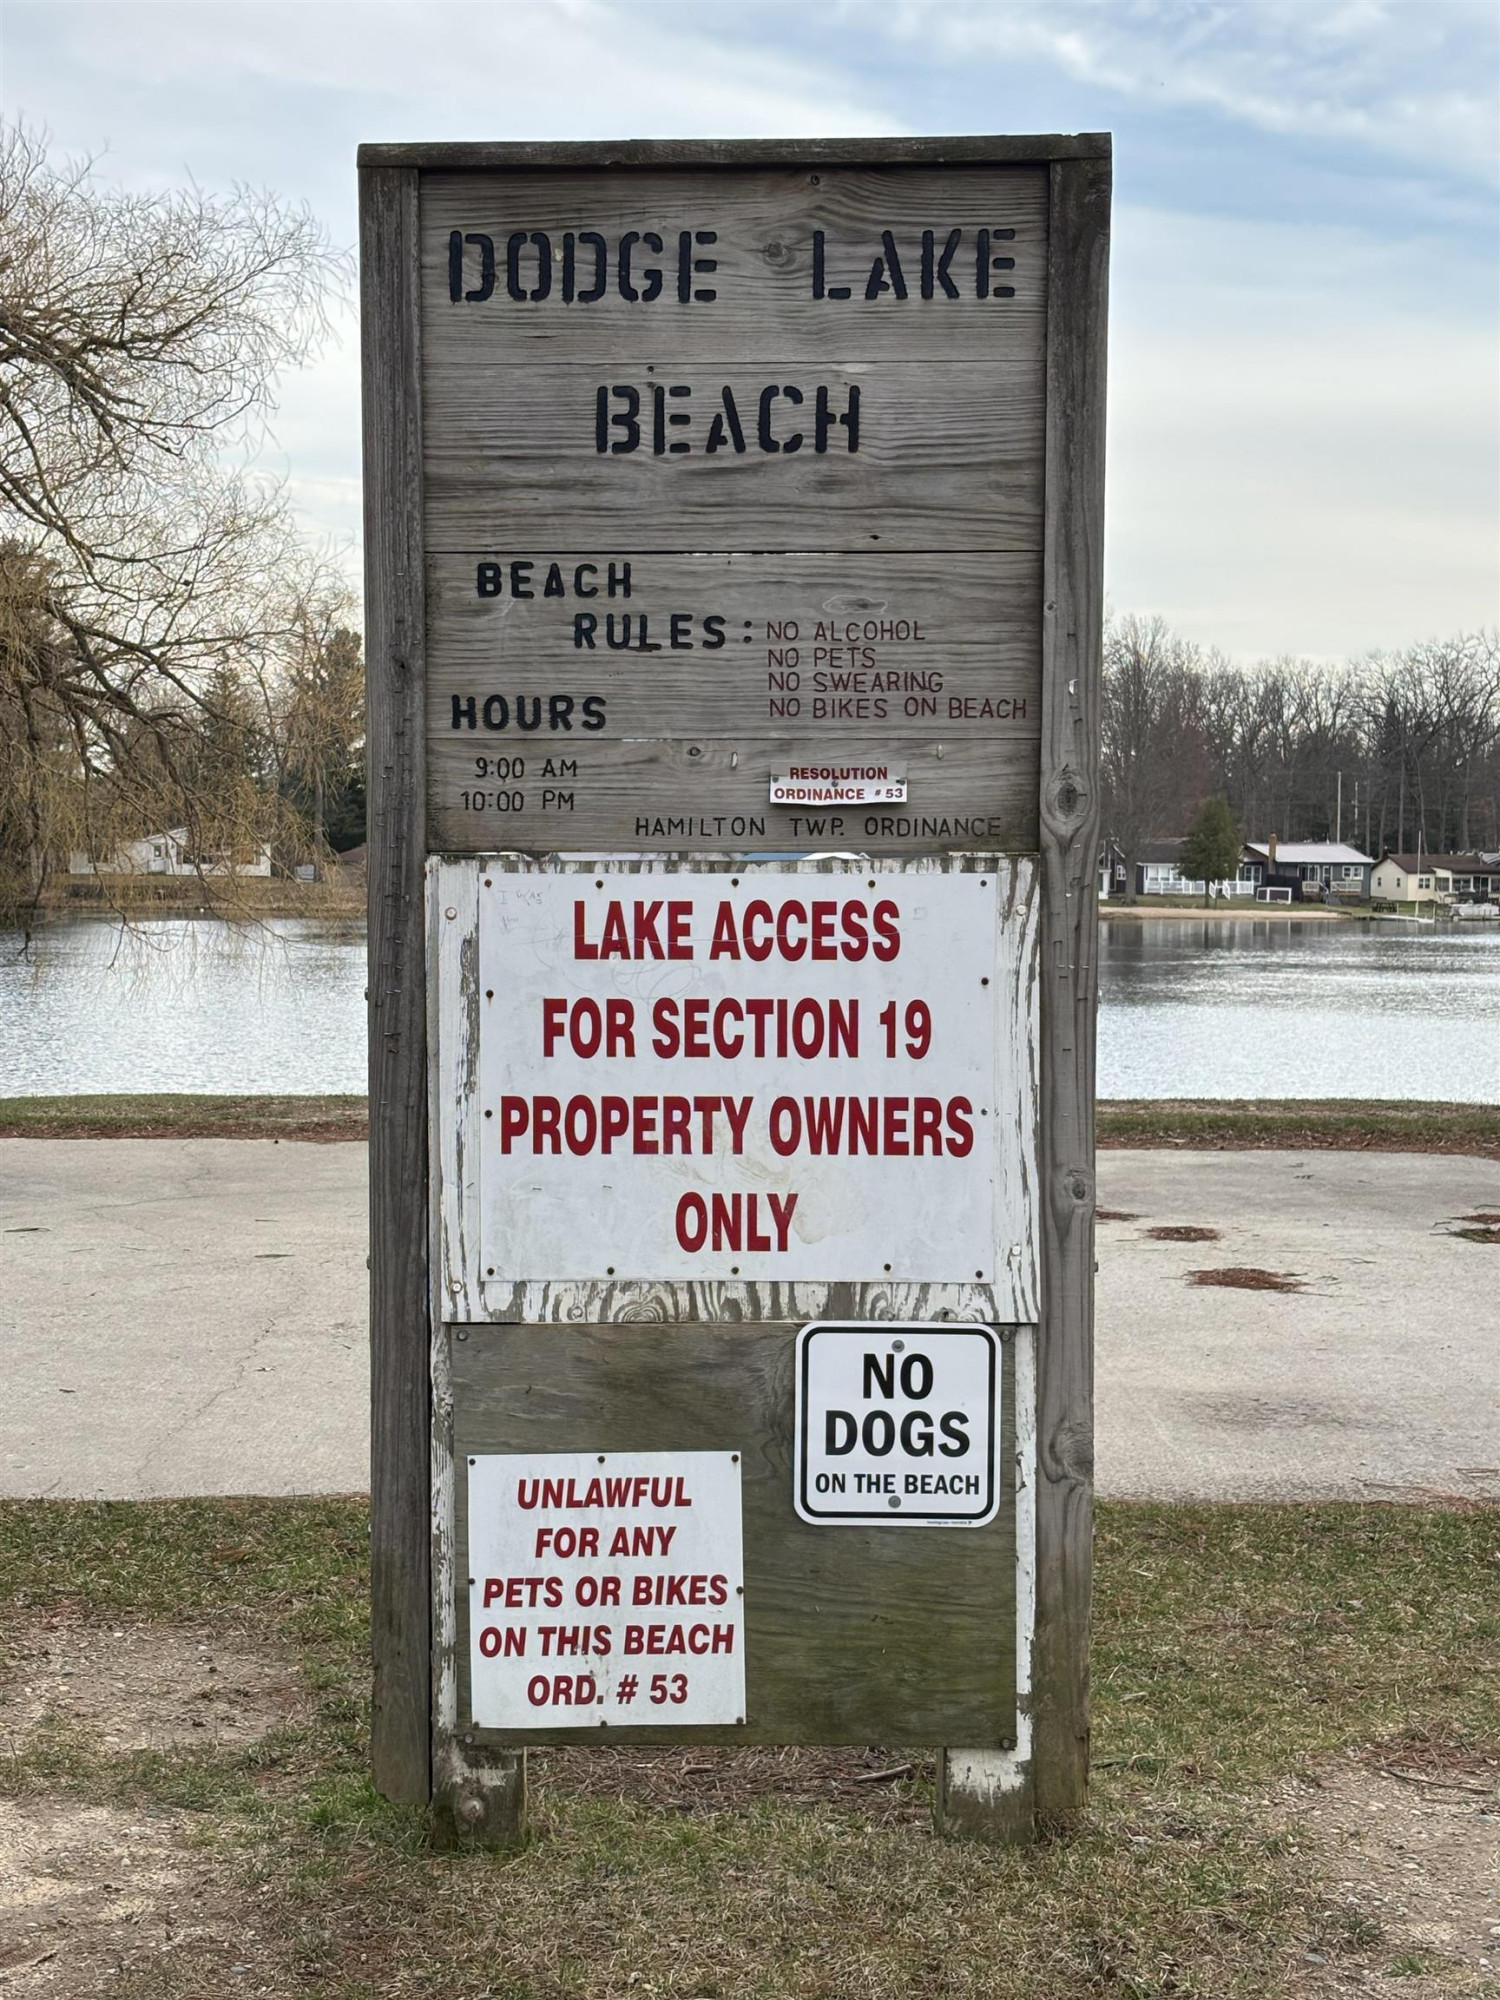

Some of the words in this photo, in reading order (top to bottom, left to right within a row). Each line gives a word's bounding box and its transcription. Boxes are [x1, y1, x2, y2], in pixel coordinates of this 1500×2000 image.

[449, 231, 717, 303] DODGE
[812, 228, 1016, 299] LAKE
[596, 385, 861, 455] BEACH
[477, 561, 631, 599] BEACH
[767, 621, 799, 641] NO
[814, 620, 925, 643] ALCOHOL
[768, 648, 799, 668] NO
[814, 648, 876, 669] PETS
[768, 672, 800, 692] NO
[813, 672, 944, 693] SWEARING
[451, 694, 606, 731] HOURS
[769, 698, 800, 718] NO
[812, 698, 887, 719] BIKES
[904, 695, 936, 717] ON
[948, 698, 1027, 720] BEACH
[475, 757, 525, 779] 9:00
[541, 758, 578, 777] AM
[790, 767, 888, 780] RESOLUTION
[460, 791, 525, 811] 10:00
[542, 790, 574, 810] PM
[774, 788, 865, 800] ORDINANCE
[885, 788, 903, 799] 53
[635, 817, 765, 836] HAMILTON
[789, 818, 845, 836] TWP.
[864, 817, 1002, 837] ORDINANCE
[573, 900, 694, 961] LAKE
[709, 899, 901, 962] ACCESS
[543, 997, 636, 1058] FOR
[652, 997, 860, 1059] SECTION
[879, 998, 932, 1060] 19
[500, 1094, 754, 1156] PROPERTY
[768, 1095, 974, 1157] OWNERS
[675, 1192, 798, 1253] ONLY
[863, 1353, 934, 1400] NO
[825, 1410, 970, 1458] DOGS
[517, 1476, 692, 1510] UNLAWFUL
[815, 1473, 846, 1494] ON
[854, 1473, 896, 1494] THE
[904, 1474, 980, 1495] BEACH
[535, 1527, 600, 1558] FOR
[608, 1526, 677, 1557] ANY
[483, 1576, 564, 1608] PETS
[575, 1575, 621, 1607] OR
[632, 1574, 728, 1606] BIKES
[479, 1626, 527, 1658] ON
[537, 1625, 612, 1656] THIS
[623, 1623, 735, 1655] BEACH
[527, 1674, 604, 1707] ORD.
[616, 1674, 639, 1705] #
[650, 1673, 689, 1705] 53
